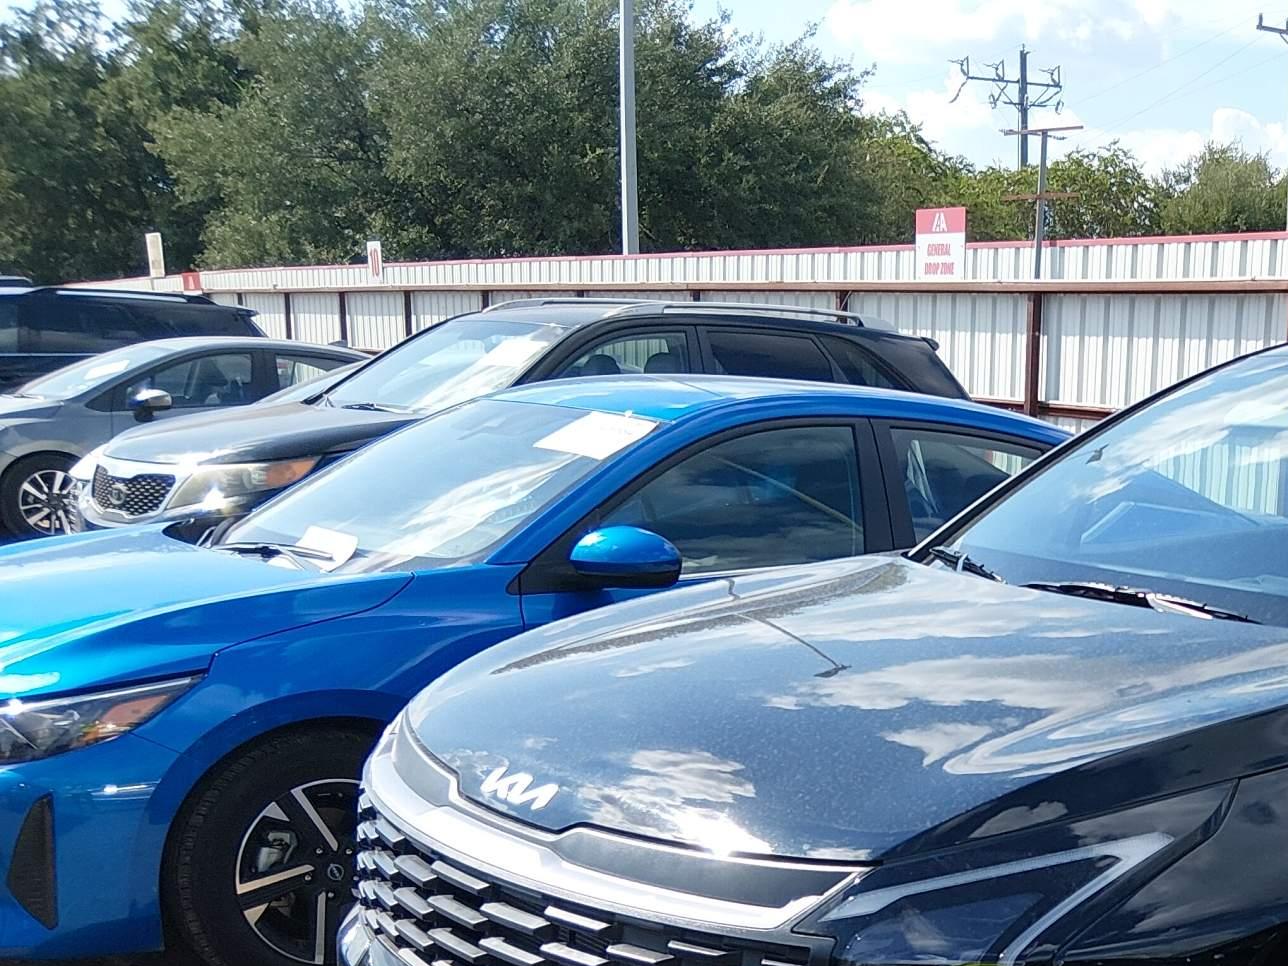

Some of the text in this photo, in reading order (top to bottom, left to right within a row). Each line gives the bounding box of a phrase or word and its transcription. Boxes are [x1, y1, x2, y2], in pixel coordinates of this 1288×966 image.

[927, 243, 951, 256] GENERAL
[924, 262, 955, 275] DROP ZONE
